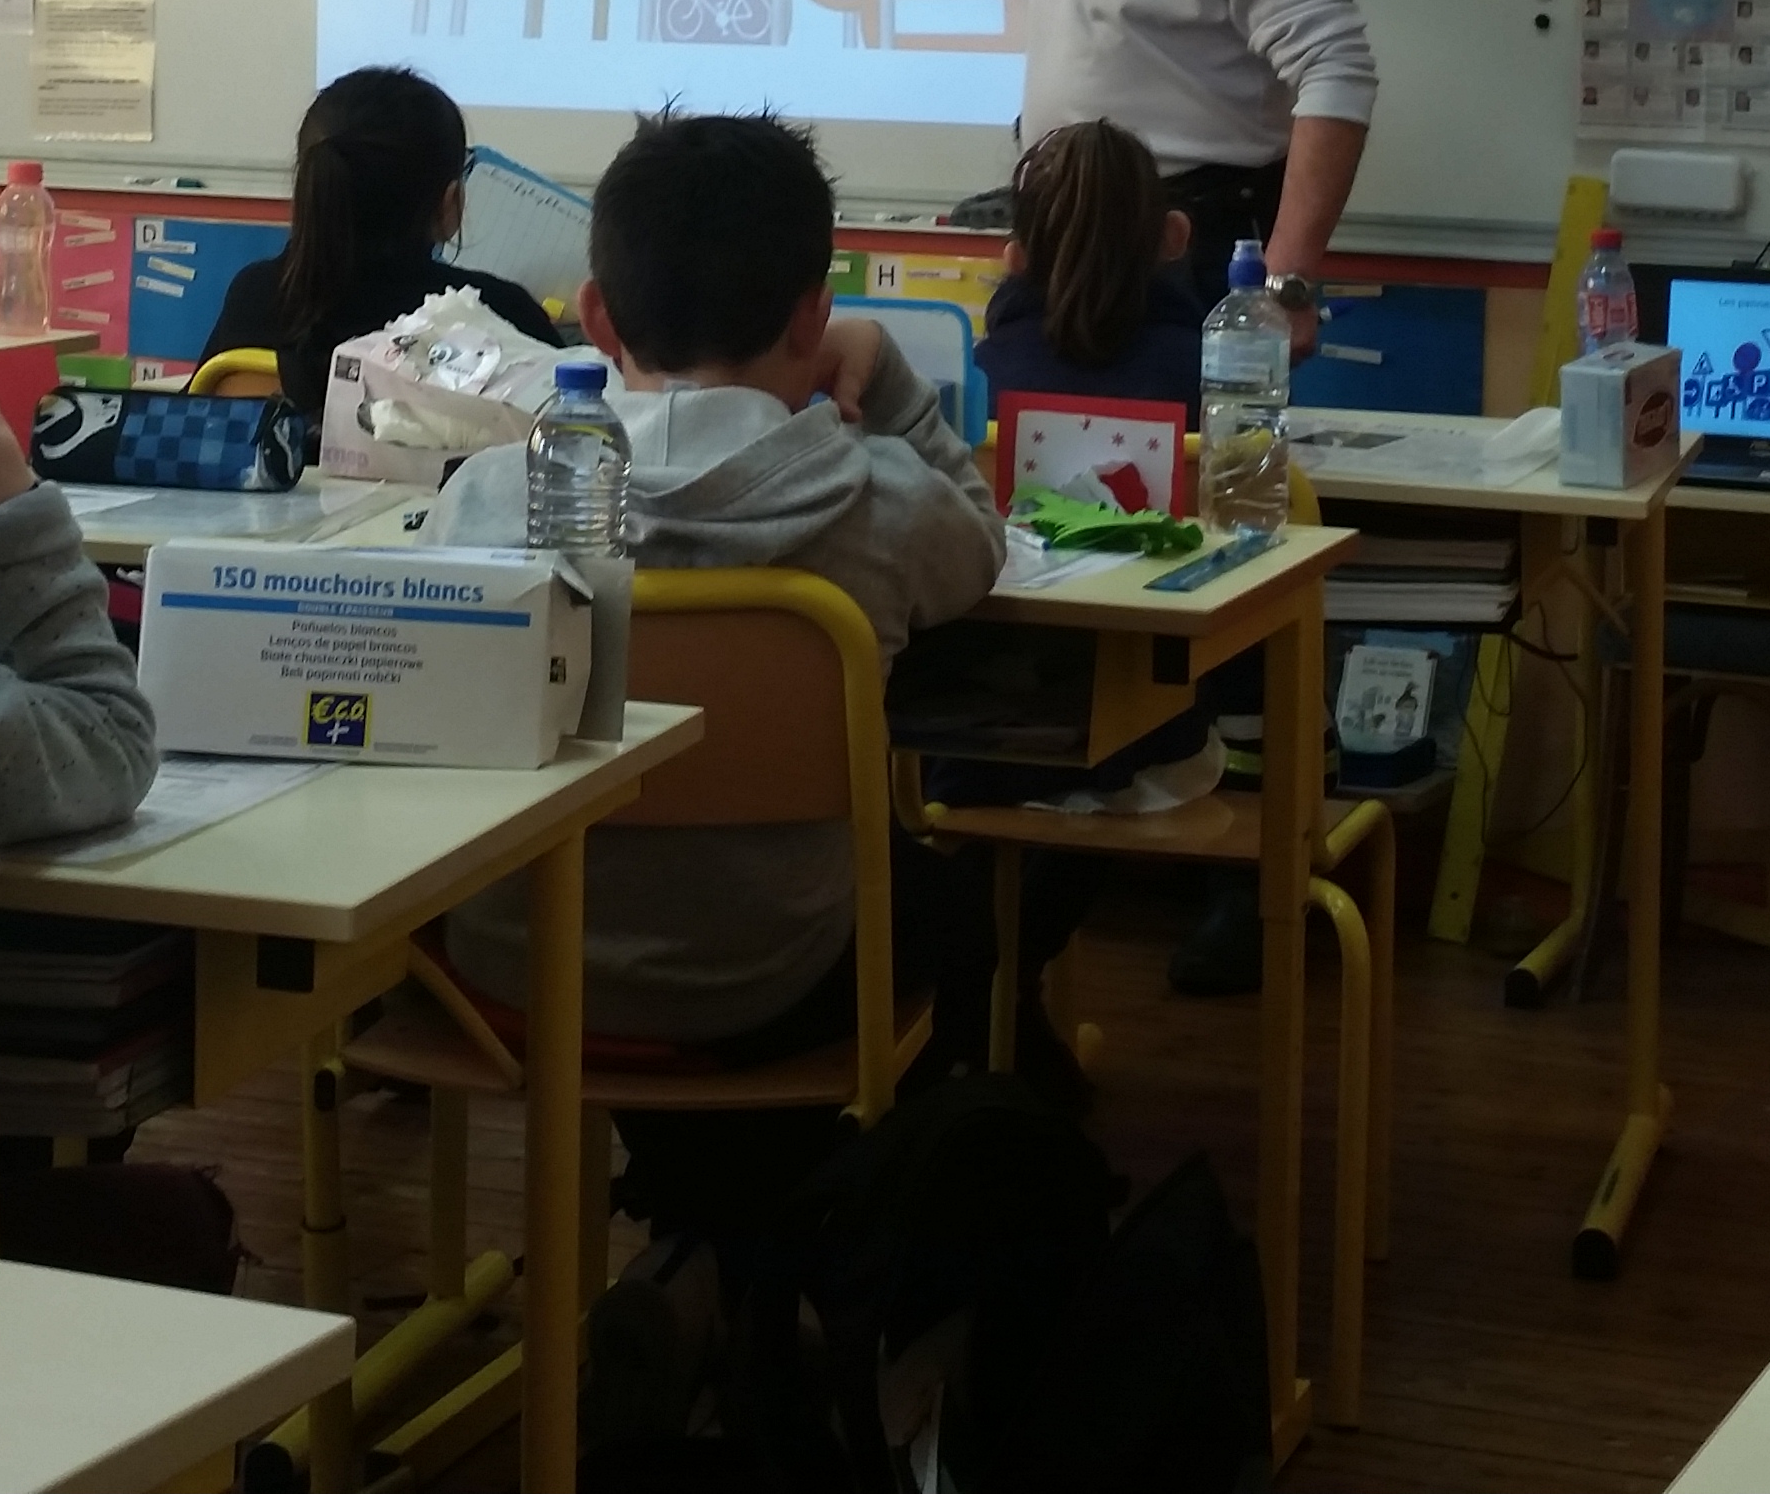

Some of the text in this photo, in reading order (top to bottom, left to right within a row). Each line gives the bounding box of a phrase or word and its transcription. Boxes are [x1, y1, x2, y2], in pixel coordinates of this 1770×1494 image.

[143, 224, 157, 244] D
[879, 264, 894, 286] H
[212, 566, 485, 604] 150 mouchoirs blancs
[292, 619, 397, 638] Pañuelos blancos
[315, 636, 329, 649] de
[333, 638, 366, 655] papel
